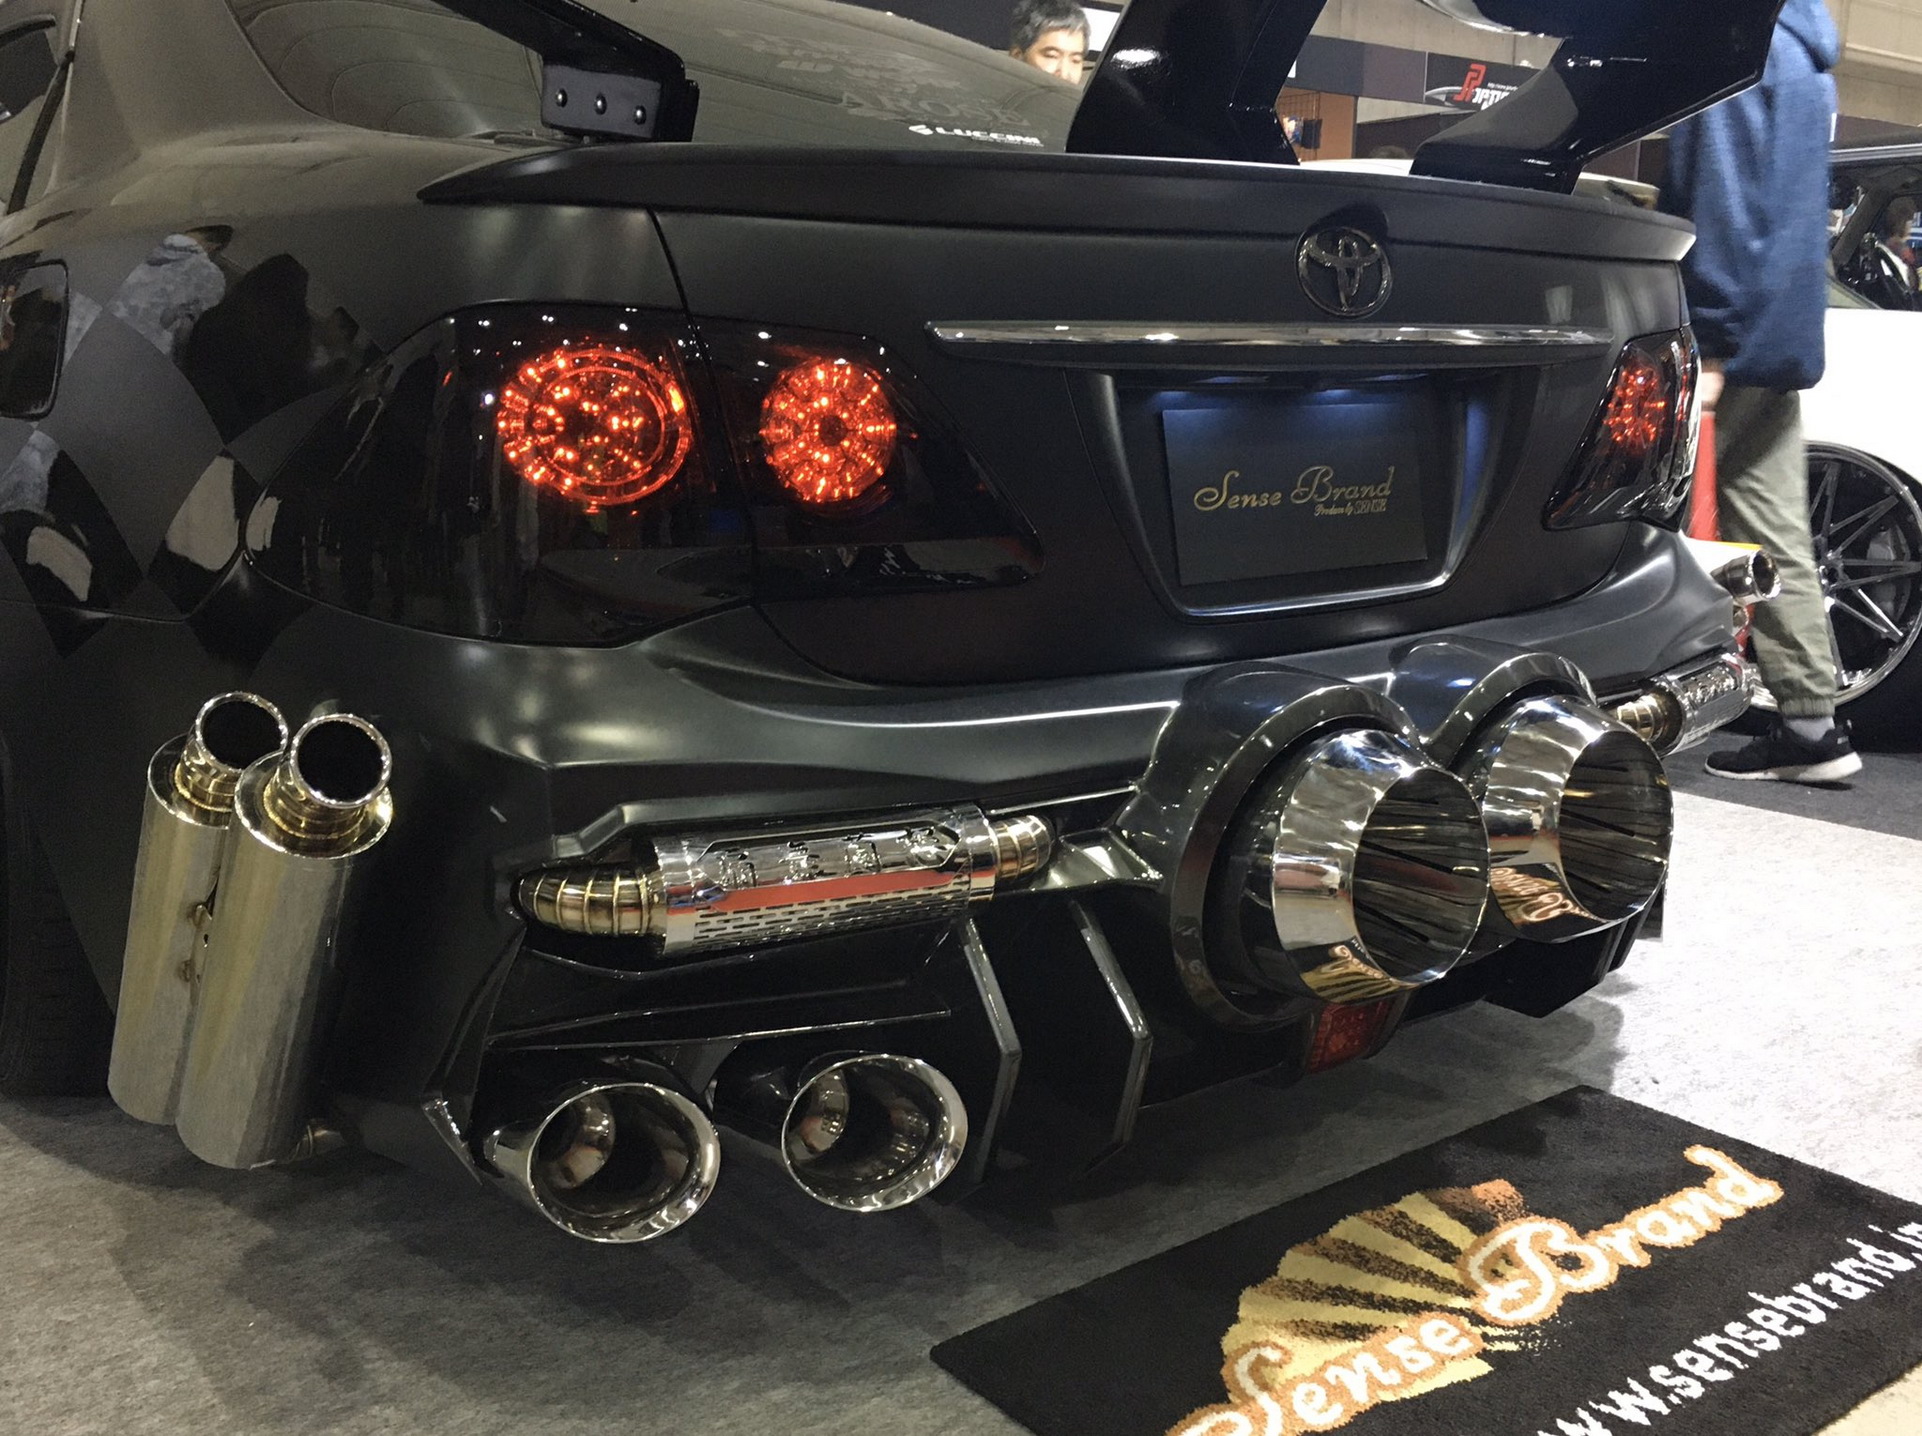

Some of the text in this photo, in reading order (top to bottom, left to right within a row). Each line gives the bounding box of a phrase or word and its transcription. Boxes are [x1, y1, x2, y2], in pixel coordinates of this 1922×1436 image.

[1193, 465, 1396, 511] Sense Brand
[1176, 1145, 1779, 1436] Sense Brand
